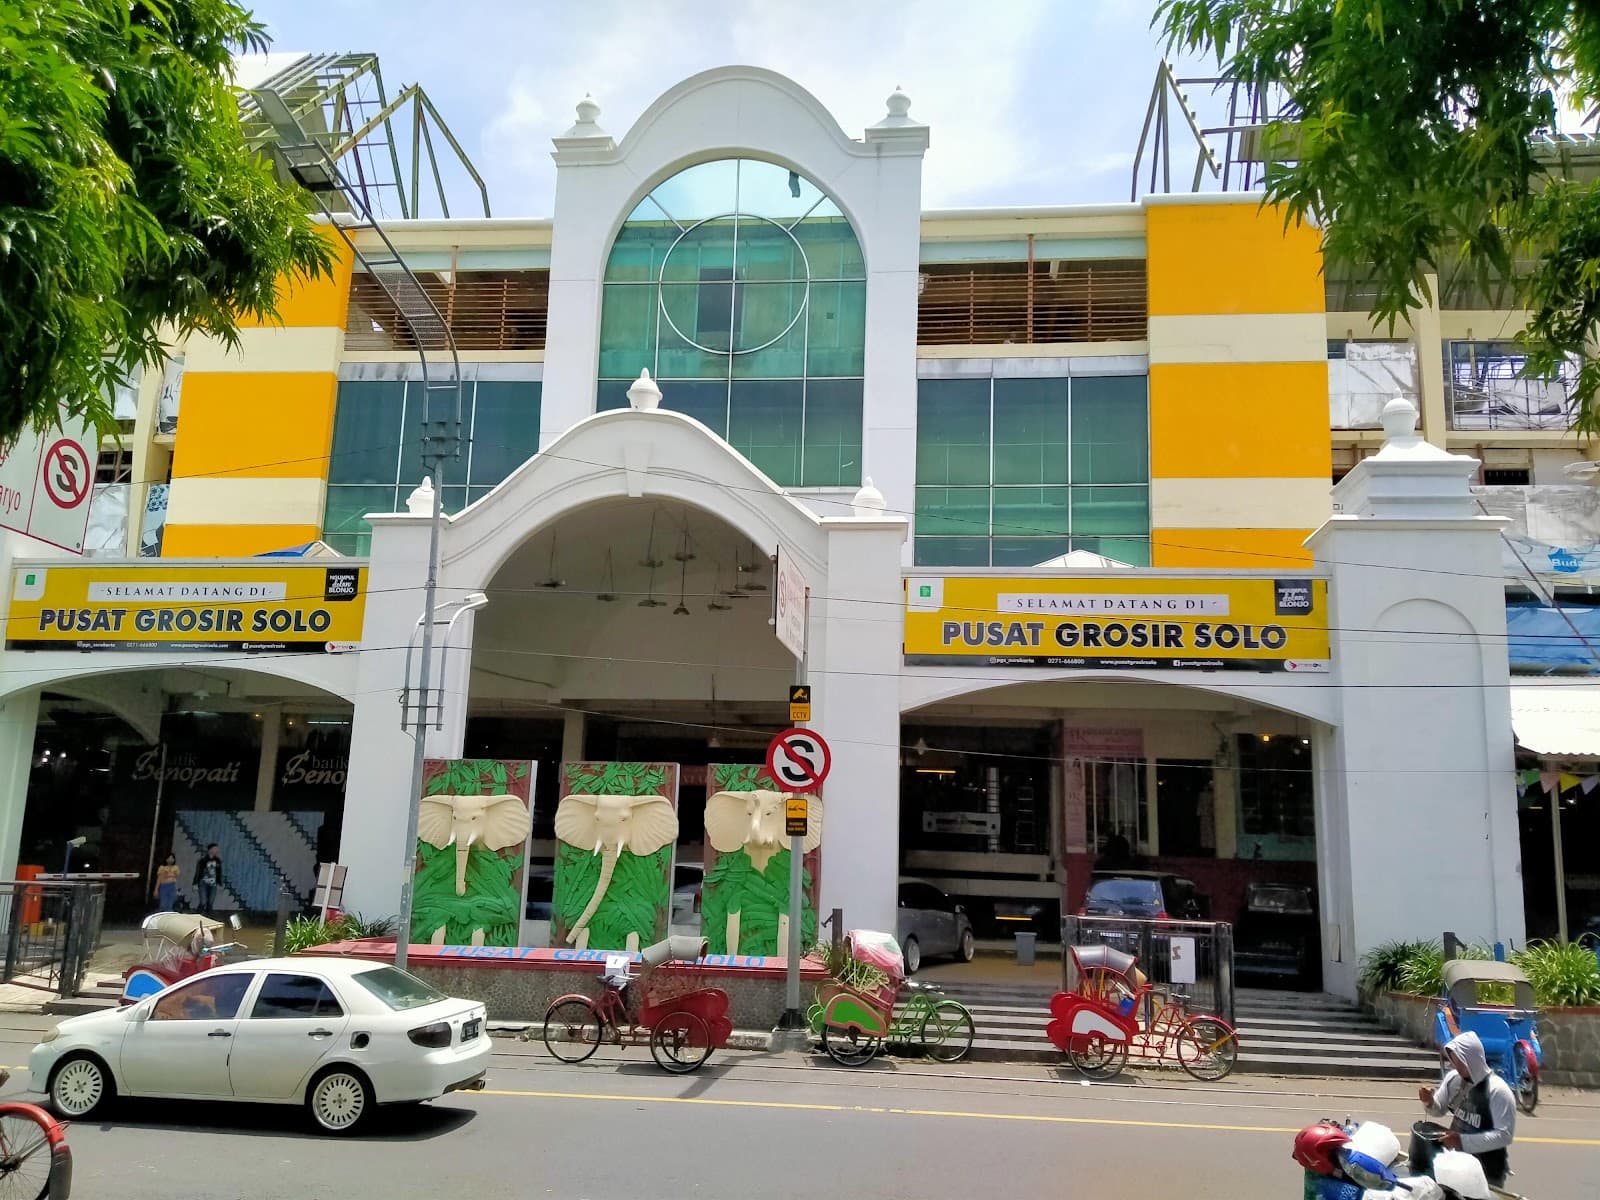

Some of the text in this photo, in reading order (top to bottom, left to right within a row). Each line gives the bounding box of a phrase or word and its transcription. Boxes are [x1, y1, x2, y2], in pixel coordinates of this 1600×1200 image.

[180, 586, 243, 596] DATANG
[1103, 599, 1177, 609] DATANG
[38, 608, 332, 633] PUSAT GROSIR SOLO
[942, 621, 1288, 650] PUSAT GROSIR SOLO
[792, 711, 808, 719] CCTV
[438, 945, 537, 960] PUSAT
